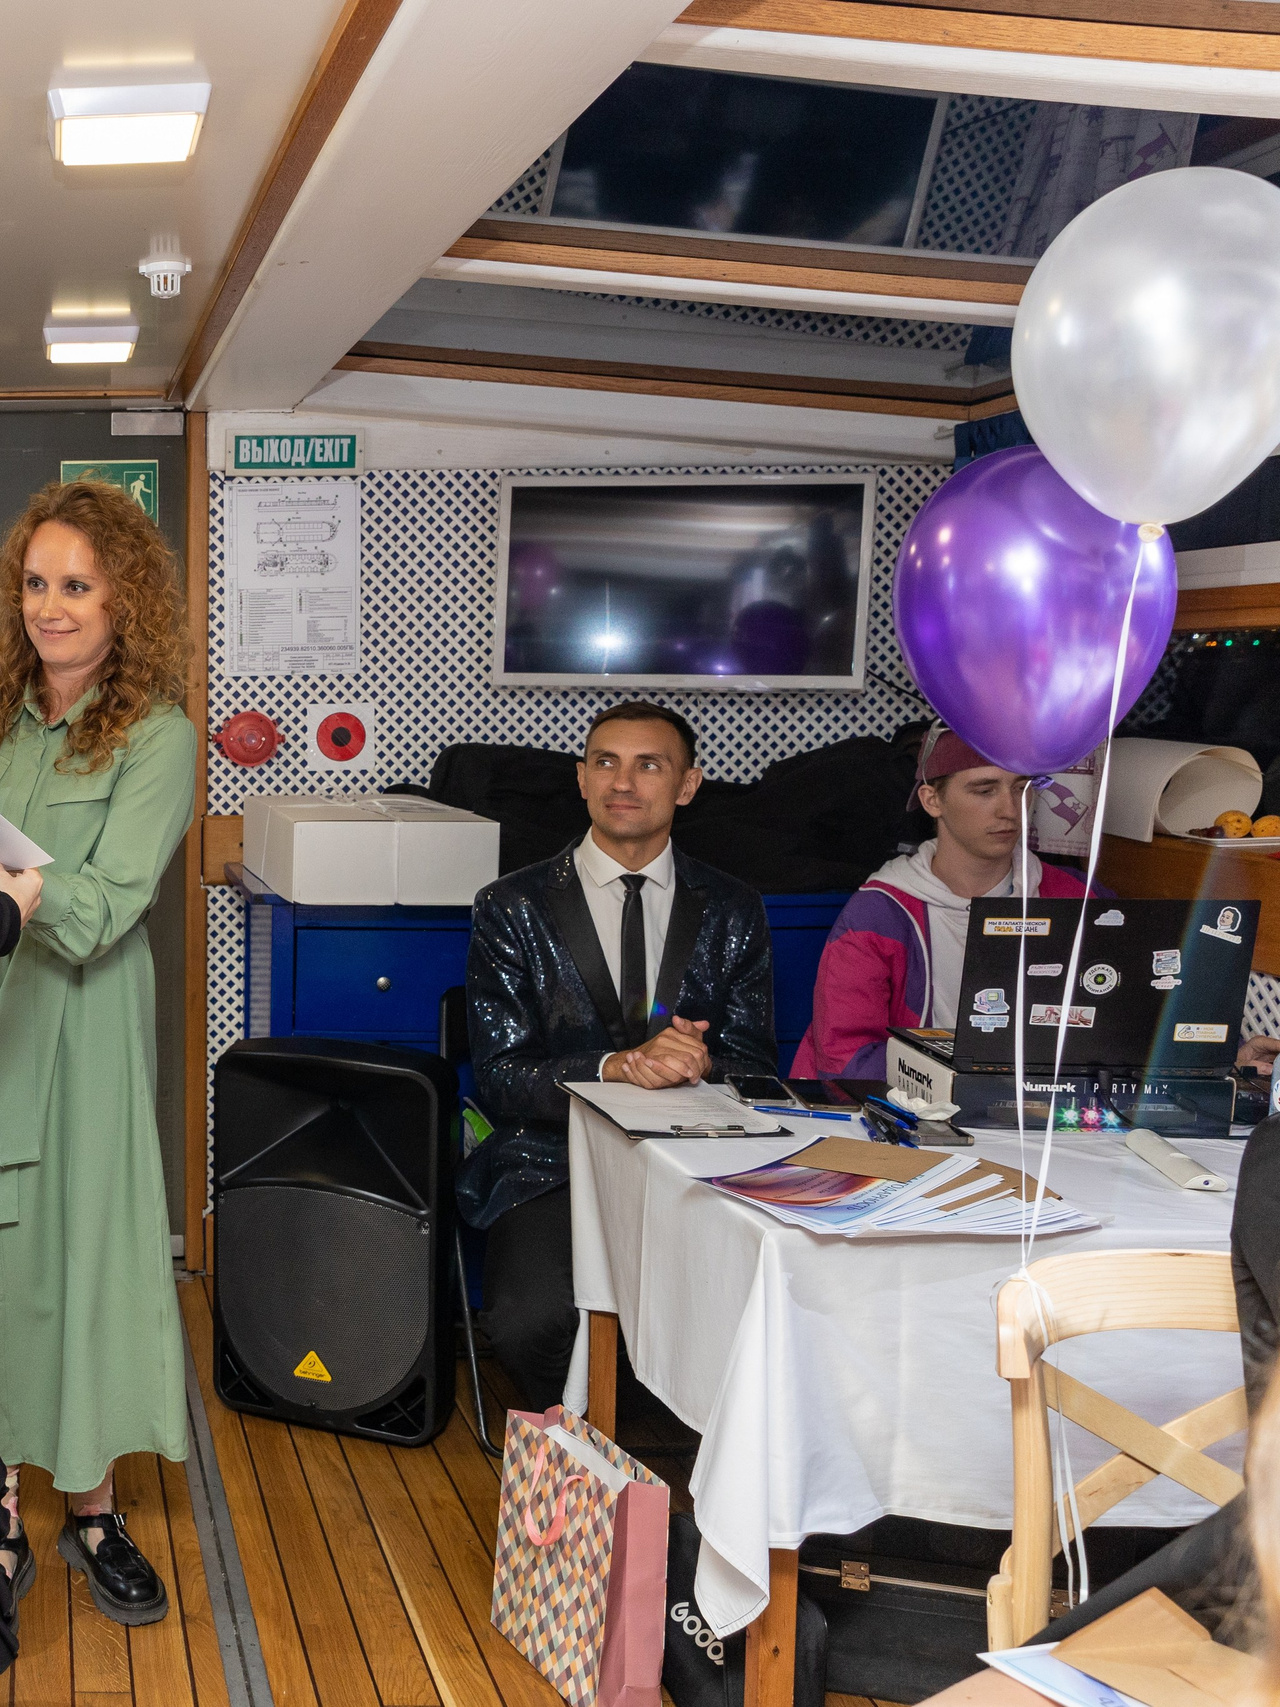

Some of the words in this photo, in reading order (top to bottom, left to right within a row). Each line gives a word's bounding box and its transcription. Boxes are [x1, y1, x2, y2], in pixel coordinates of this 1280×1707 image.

[240, 438, 351, 467] ВЫХОД/EXIT
[898, 1057, 933, 1090] Numark
[1022, 1081, 1076, 1093] Numark
[1093, 1083, 1137, 1094] PRTY
